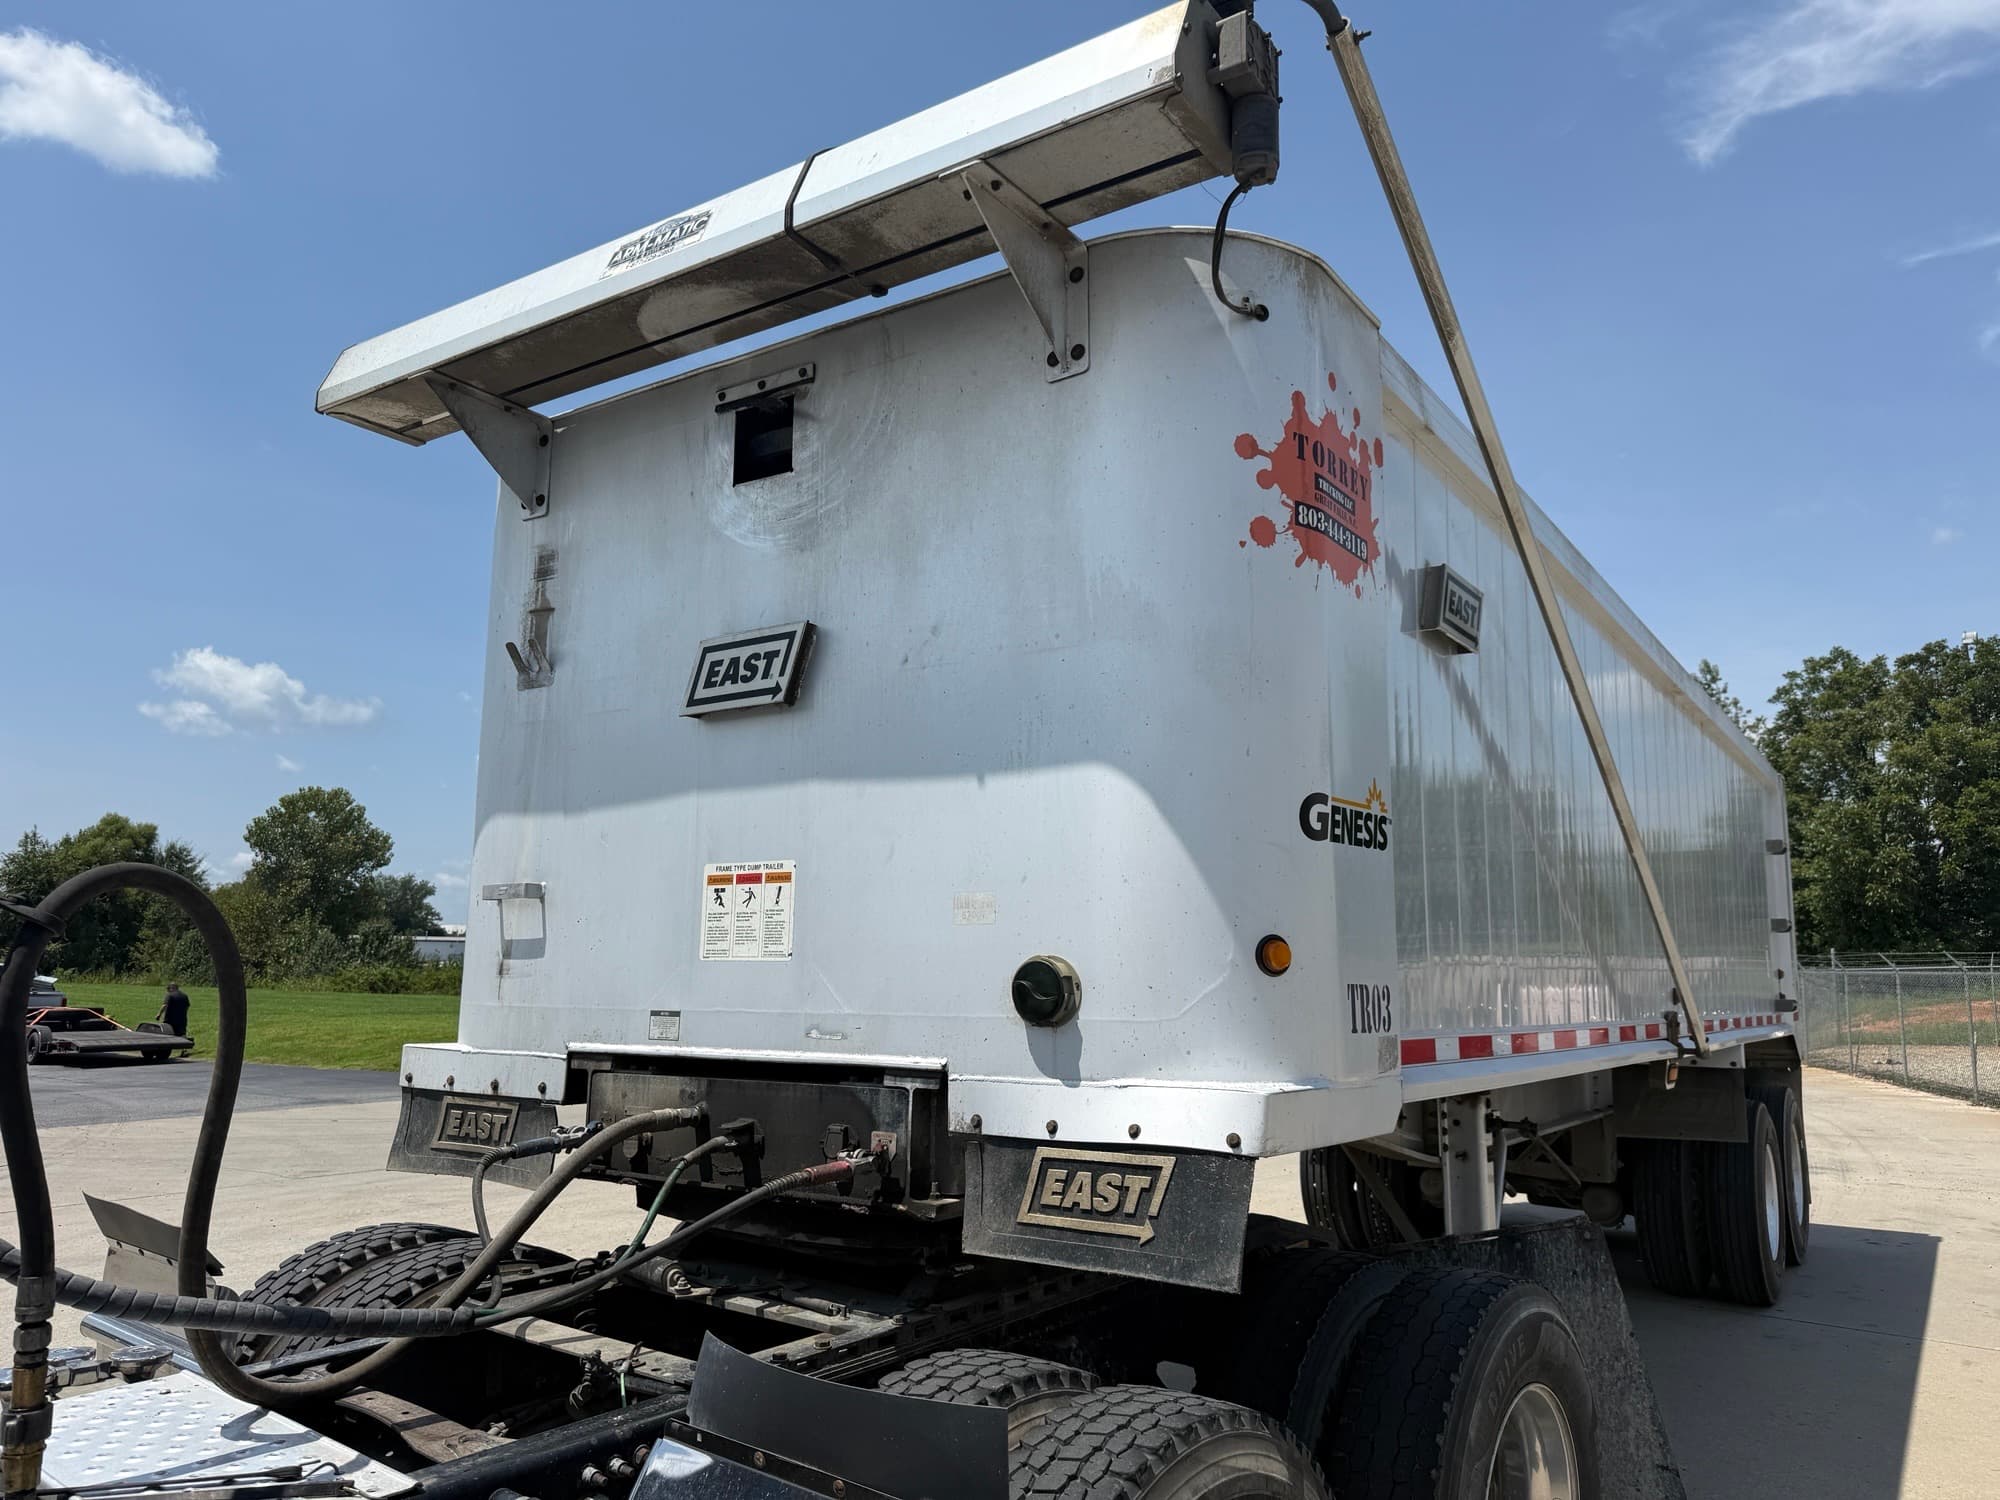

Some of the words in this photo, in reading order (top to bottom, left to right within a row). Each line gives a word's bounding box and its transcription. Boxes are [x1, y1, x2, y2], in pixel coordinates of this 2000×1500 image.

[1293, 431, 1369, 501] TORREY
[1318, 478, 1344, 504] TRUCKING
[1298, 504, 1367, 560] 803-444-3119
[1448, 589, 1477, 629] EAST
[702, 649, 781, 690] EAST
[1299, 792, 1388, 851] GENESIS
[747, 863, 761, 871] DUMP
[1347, 984, 1391, 1033] TR03
[447, 1109, 508, 1142] EAST
[1040, 1168, 1152, 1214] EAST
